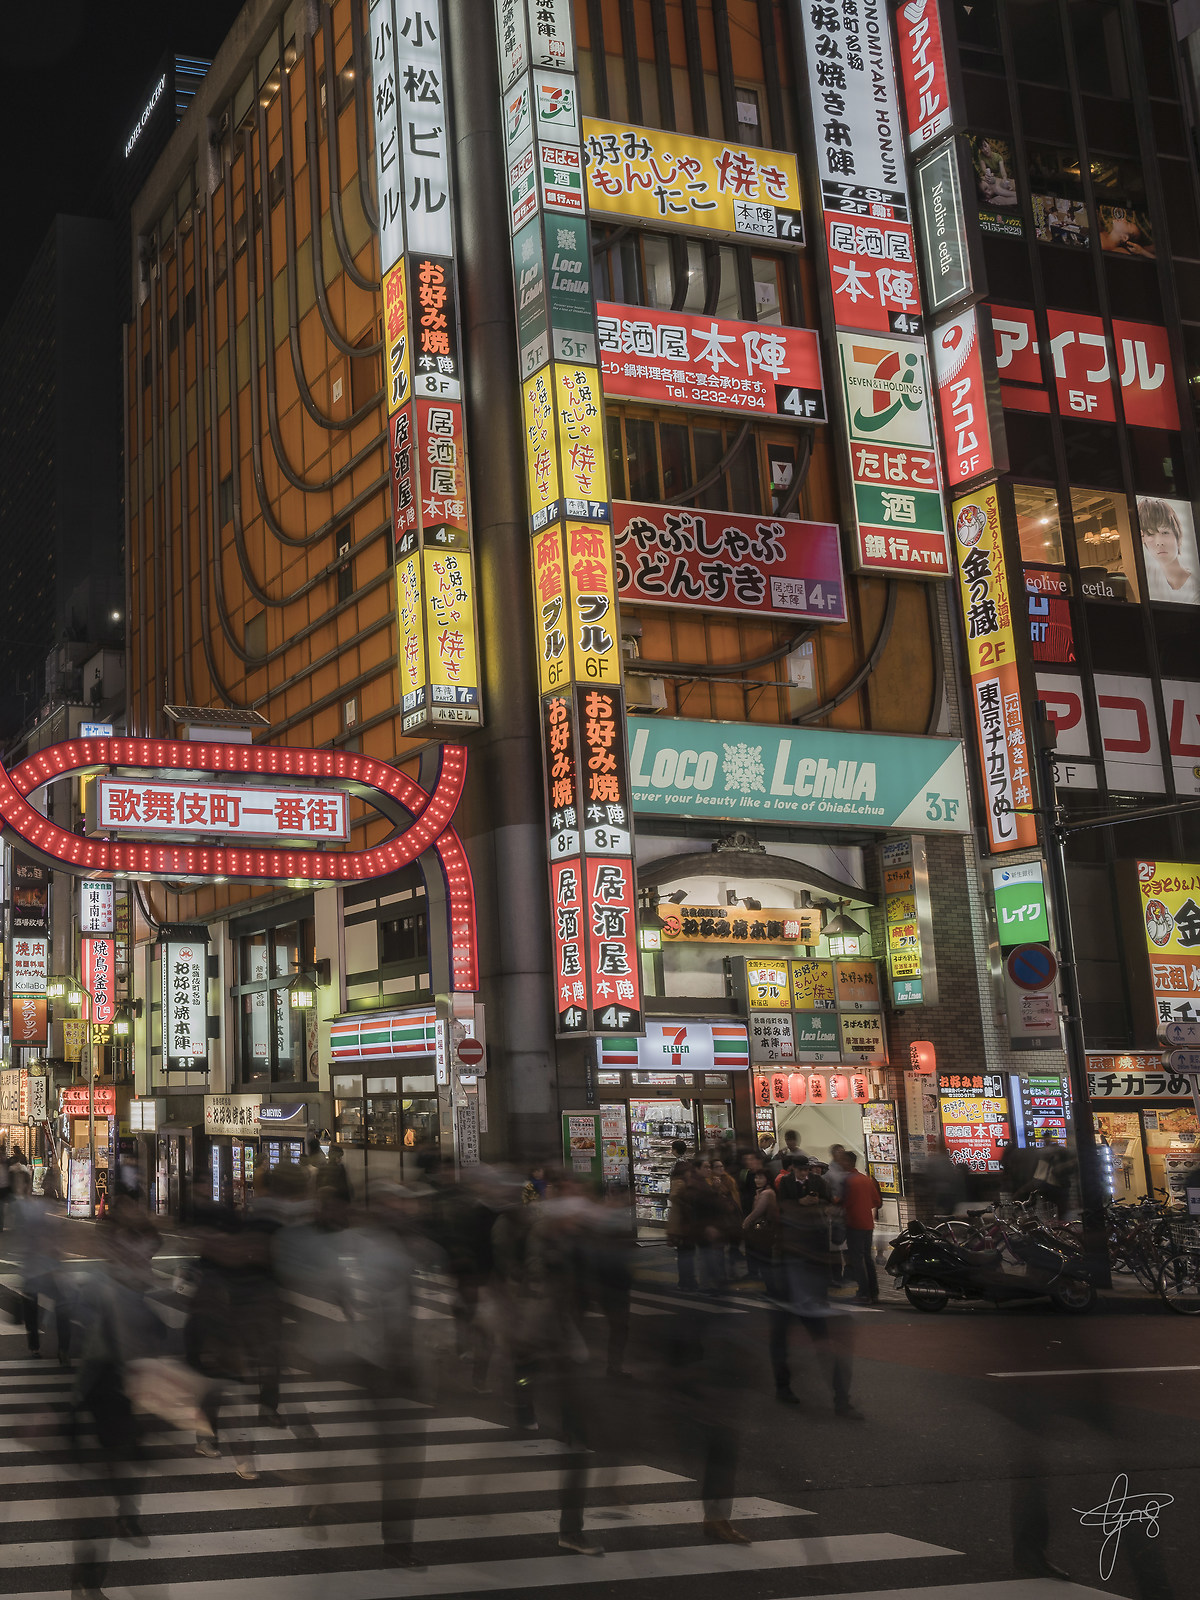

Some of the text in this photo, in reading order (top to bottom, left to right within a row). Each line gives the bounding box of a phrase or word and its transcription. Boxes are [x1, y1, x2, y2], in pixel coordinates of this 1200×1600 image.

[507, 62, 523, 85] 2F
[540, 55, 566, 67] 2F
[908, 17, 940, 123] アイフル
[810, 3, 856, 177] 好み焼き本陣
[125, 73, 166, 158] HOTEL GRACERY
[400, 11, 448, 215] 小松ビル
[375, 20, 401, 232] 小松ビル
[922, 118, 941, 141] 5F
[543, 148, 579, 167] たばこ
[875, 109, 898, 185] HONJIN
[510, 151, 533, 184] たばこ
[553, 169, 570, 186] 酒
[591, 153, 701, 196] もんじゃ
[715, 148, 788, 199] 焼き
[546, 191, 580, 207] 銀行ATM
[653, 181, 717, 215] たこ
[839, 199, 867, 213] 2F
[737, 204, 773, 223] 本陣
[777, 213, 800, 237] 7F
[931, 180, 952, 276] Neolive cetla
[829, 221, 913, 263] 居酒屋
[832, 259, 917, 311] 本陣
[419, 260, 450, 355] お好み焼
[386, 266, 408, 405] 麻雀ブル
[893, 313, 919, 334] 4F
[527, 346, 543, 371] 3F
[561, 337, 588, 358] 3F
[991, 318, 1165, 390] アイフル
[419, 355, 455, 373] 本陣
[425, 376, 450, 393] 8F
[574, 370, 597, 417] お好み
[665, 384, 766, 408] Tel. 3232-4794
[883, 381, 923, 395] HOLDINGS
[562, 376, 591, 436] もんじゃ
[783, 388, 817, 417] 4F
[1068, 390, 1098, 413] 5F
[561, 409, 580, 440] たこ
[949, 377, 980, 456] アコム
[394, 412, 413, 512] 居酒屋
[427, 407, 457, 496] 居酒屋
[534, 449, 551, 501] 焼き
[568, 443, 596, 495] 焼き
[855, 448, 935, 485] たばこ
[959, 455, 980, 476] 3F
[397, 506, 415, 530] 本陣
[422, 496, 465, 520] 本陣
[589, 502, 605, 518] 7F
[880, 491, 916, 525] 酒
[435, 528, 455, 543] 4F
[864, 534, 944, 566] 銀行ATM
[445, 555, 468, 602] お好み
[570, 525, 613, 655] 麻雀ブル
[772, 581, 804, 596] 居酒屋
[1026, 575, 1115, 598] eolive cetla
[432, 561, 461, 622] もんじゃ
[537, 530, 566, 661] 麻雀ブル
[778, 594, 800, 606] 本陣
[809, 583, 837, 610] 4F
[961, 546, 1000, 640] 金の蔵
[430, 596, 449, 627] たこ
[437, 629, 465, 681] 焼き
[978, 641, 1006, 667] 2F
[548, 660, 564, 685] 6F
[585, 657, 609, 678] 6F
[457, 687, 473, 703] 7F
[438, 709, 472, 721] 小松ビル
[1005, 694, 1021, 726] 元祖
[549, 697, 573, 809] お好み焼
[585, 691, 620, 802] お好み焼
[977, 682, 1013, 839] 東京チカラめし
[1006, 728, 1031, 804] 焼き牛丼
[108, 787, 339, 833] 歌舞伎町一番街
[587, 803, 625, 825] 本陣
[665, 793, 815, 811] your beauty like love of
[924, 792, 960, 822] 3F
[552, 806, 576, 830] 本陣
[557, 834, 573, 852] 8F
[594, 829, 621, 849] 8F
[1138, 862, 1155, 881] 2F
[89, 890, 100, 931] 東南荘
[557, 867, 582, 977] 居酒屋
[591, 864, 632, 977] 居酒屋
[1002, 902, 1042, 924] レイク
[892, 925, 915, 938] 麻雀
[899, 935, 917, 946] ブル
[15, 941, 45, 957] 焼肉
[93, 940, 108, 1022] 焼鳥釜めし
[793, 962, 819, 978] お好み
[794, 970, 828, 989] もんじゃ
[1153, 965, 1188, 990] 元祖
[560, 980, 585, 1001] 本陣
[596, 979, 634, 1001] 本陣
[757, 986, 780, 999] ブル
[173, 961, 191, 1050] お好み焼本陣
[565, 1007, 582, 1027] 4F
[601, 1006, 631, 1028] 4F
[21, 1000, 37, 1039] ステップ
[93, 1023, 109, 1033] 1F
[662, 1044, 691, 1054] ELEVEN
[178, 1057, 195, 1067] 2F
[940, 1075, 984, 1088] お好み焼
[981, 1100, 1001, 1112] 焼き
